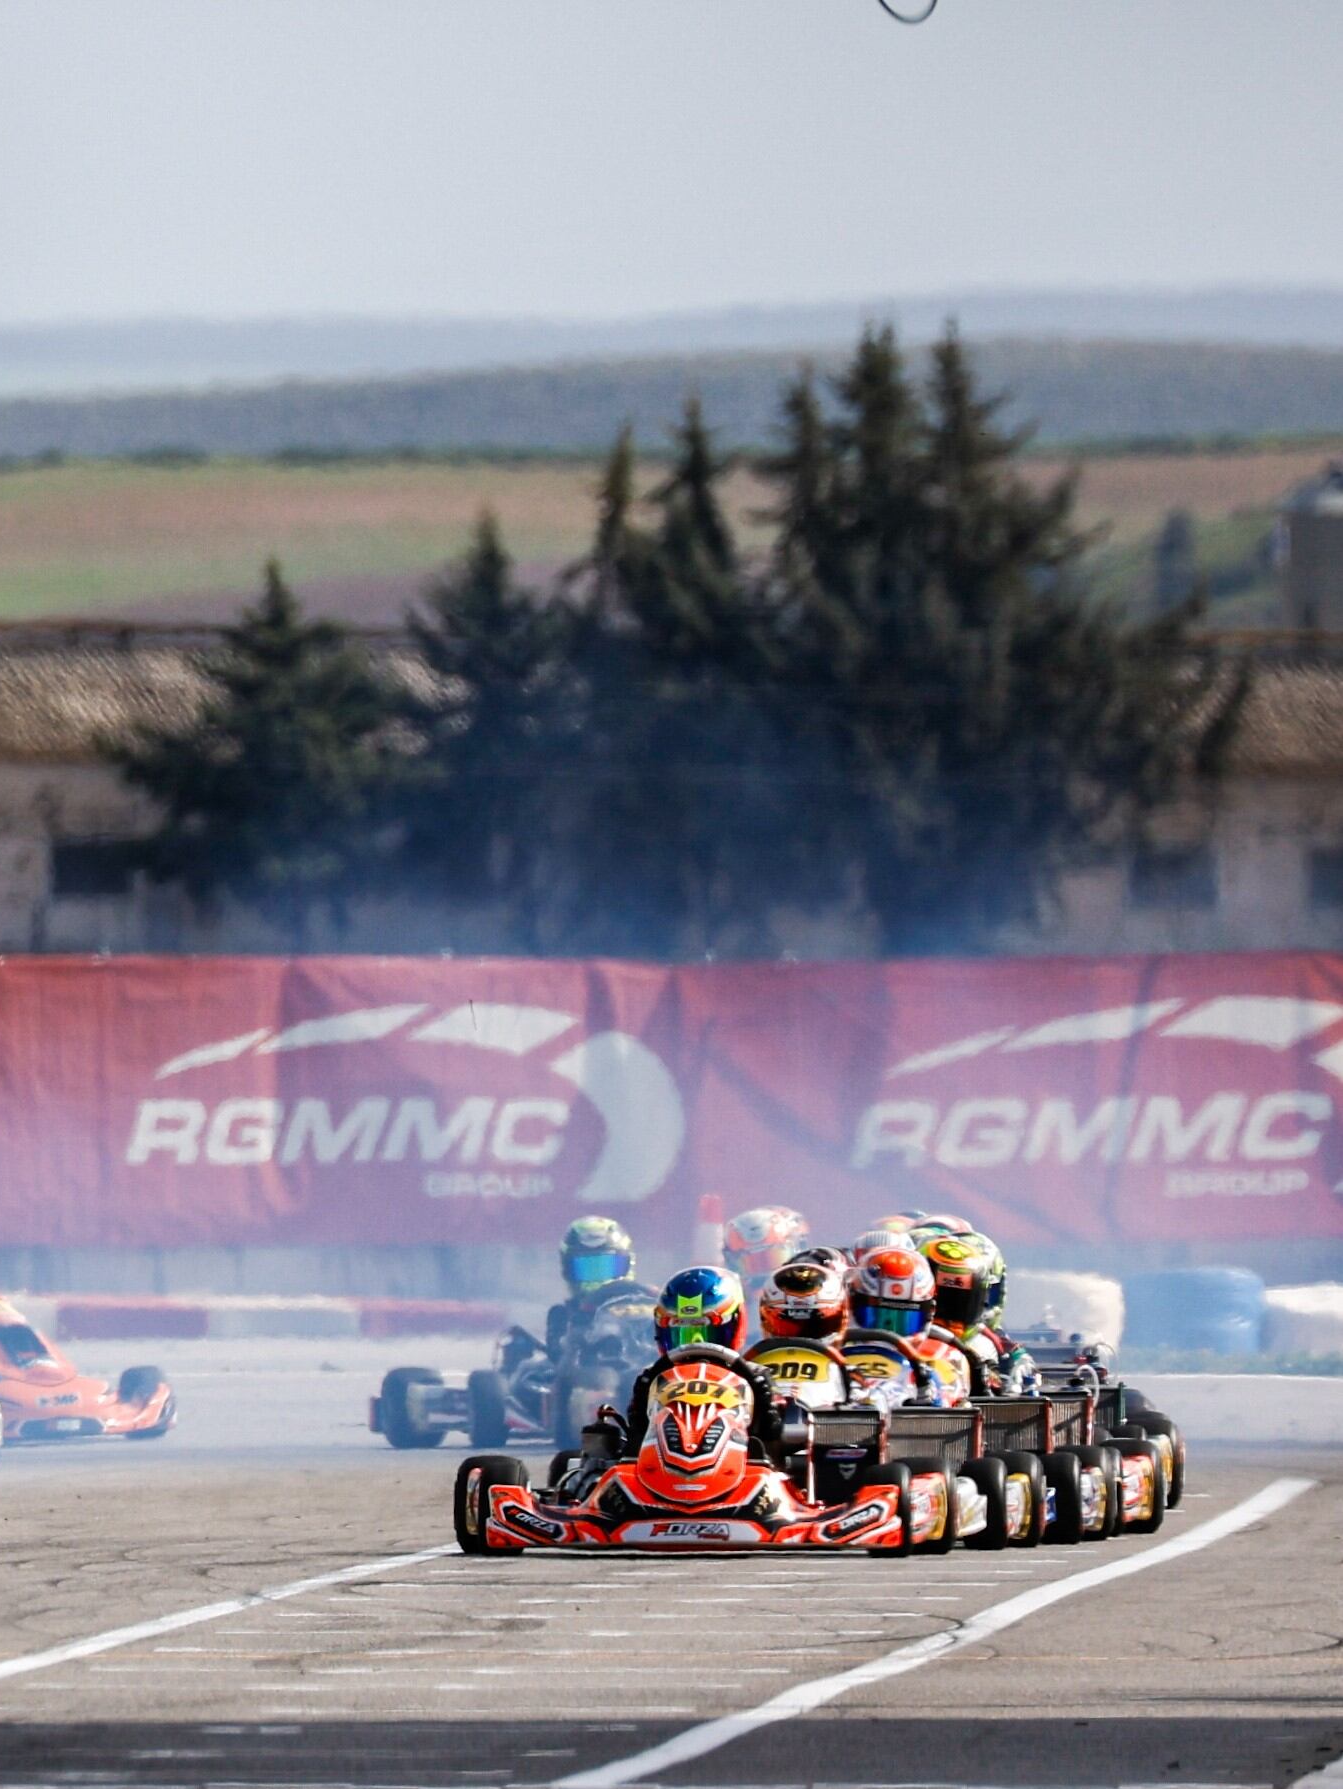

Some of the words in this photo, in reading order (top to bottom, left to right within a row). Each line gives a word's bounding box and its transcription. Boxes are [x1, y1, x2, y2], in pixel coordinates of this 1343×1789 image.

[125, 1096, 570, 1165] RGMMC
[851, 1091, 1333, 1169] RGMMC
[650, 1522, 729, 1538] FORZA
